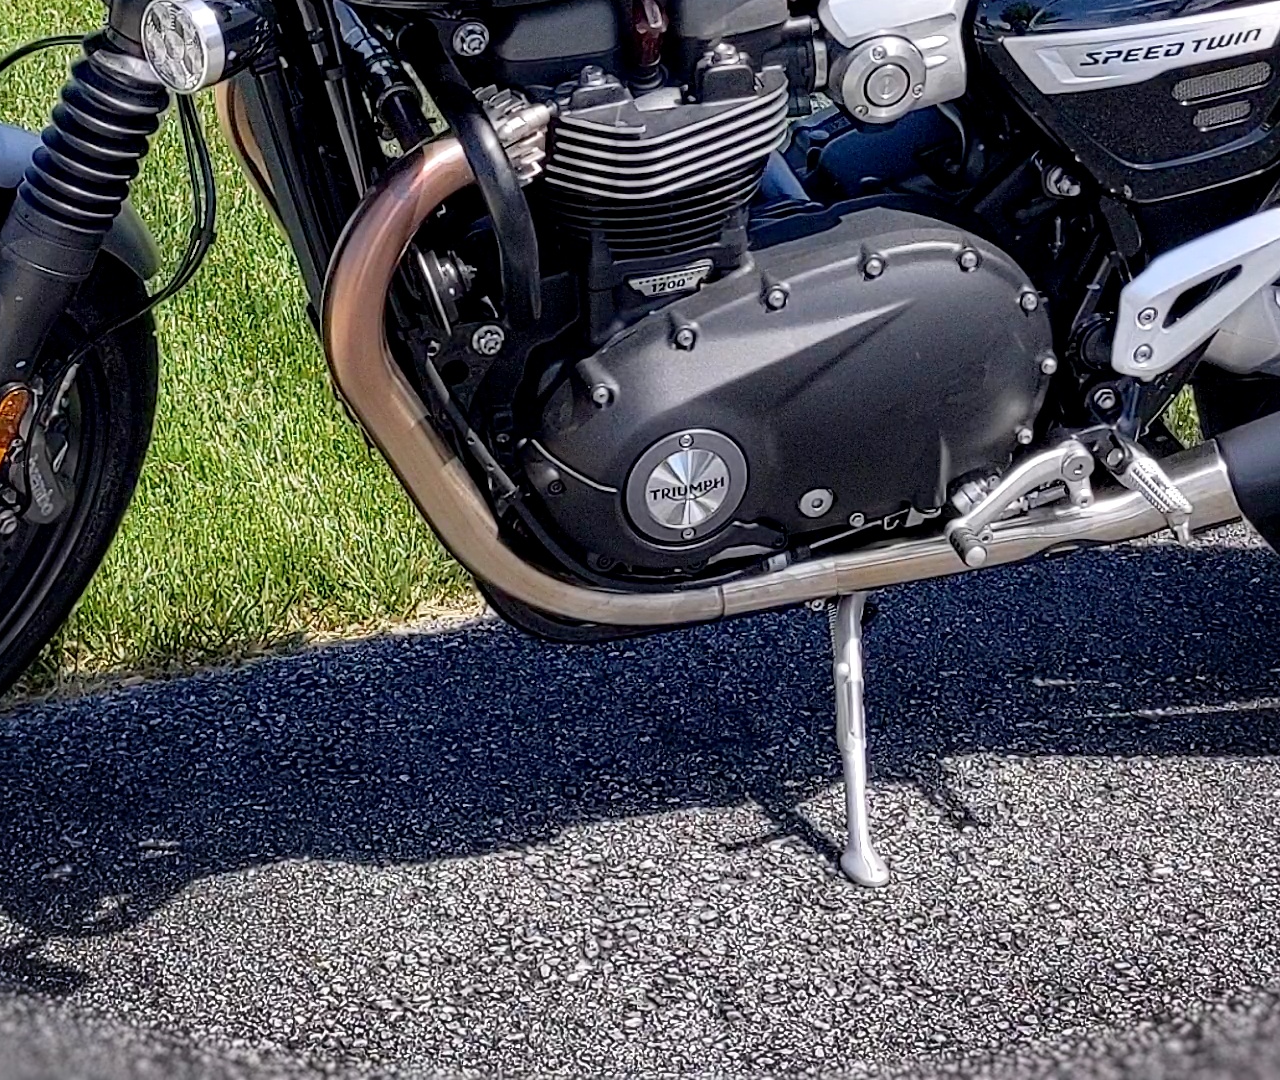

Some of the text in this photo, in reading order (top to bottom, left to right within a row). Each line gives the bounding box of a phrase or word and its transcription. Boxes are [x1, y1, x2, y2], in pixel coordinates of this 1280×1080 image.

[1080, 28, 1262, 67] SPEED TWIN
[651, 278, 686, 293] 1200
[650, 476, 725, 502] TRIUMPH
